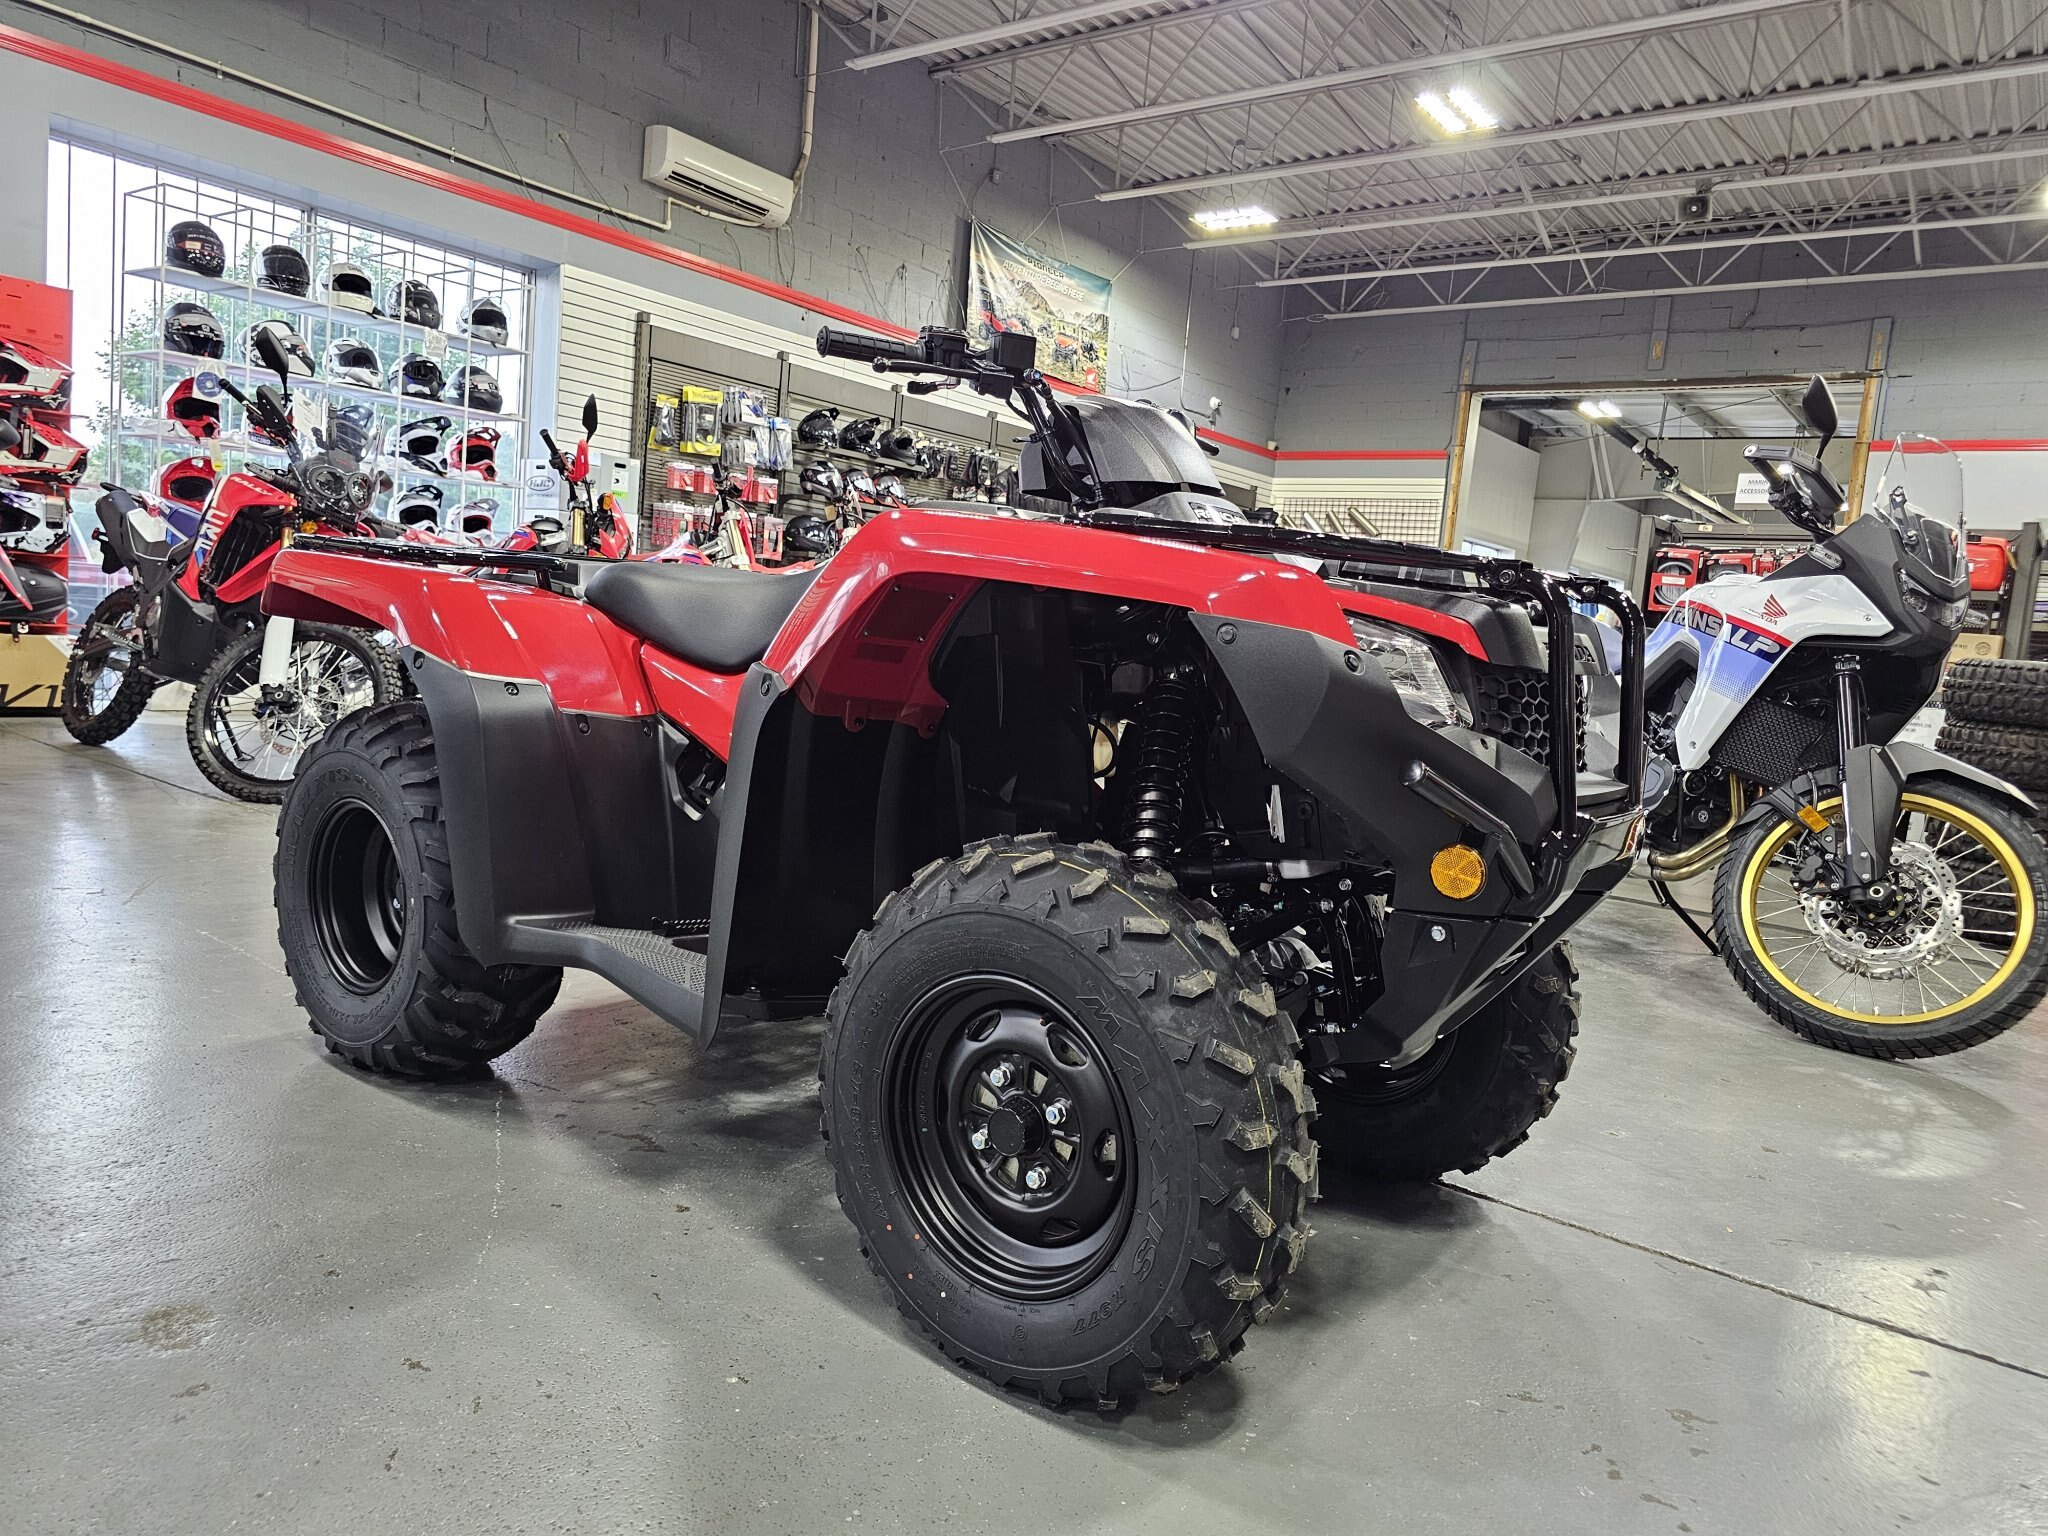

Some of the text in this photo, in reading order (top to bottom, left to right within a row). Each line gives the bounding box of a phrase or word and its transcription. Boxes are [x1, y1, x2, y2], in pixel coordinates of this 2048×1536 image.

[1003, 259, 1047, 284] ADVENTURE
[230, 476, 274, 497] RALLY
[1667, 605, 1781, 655] TRANSALP
[1075, 996, 1170, 1282] MAXXIS
